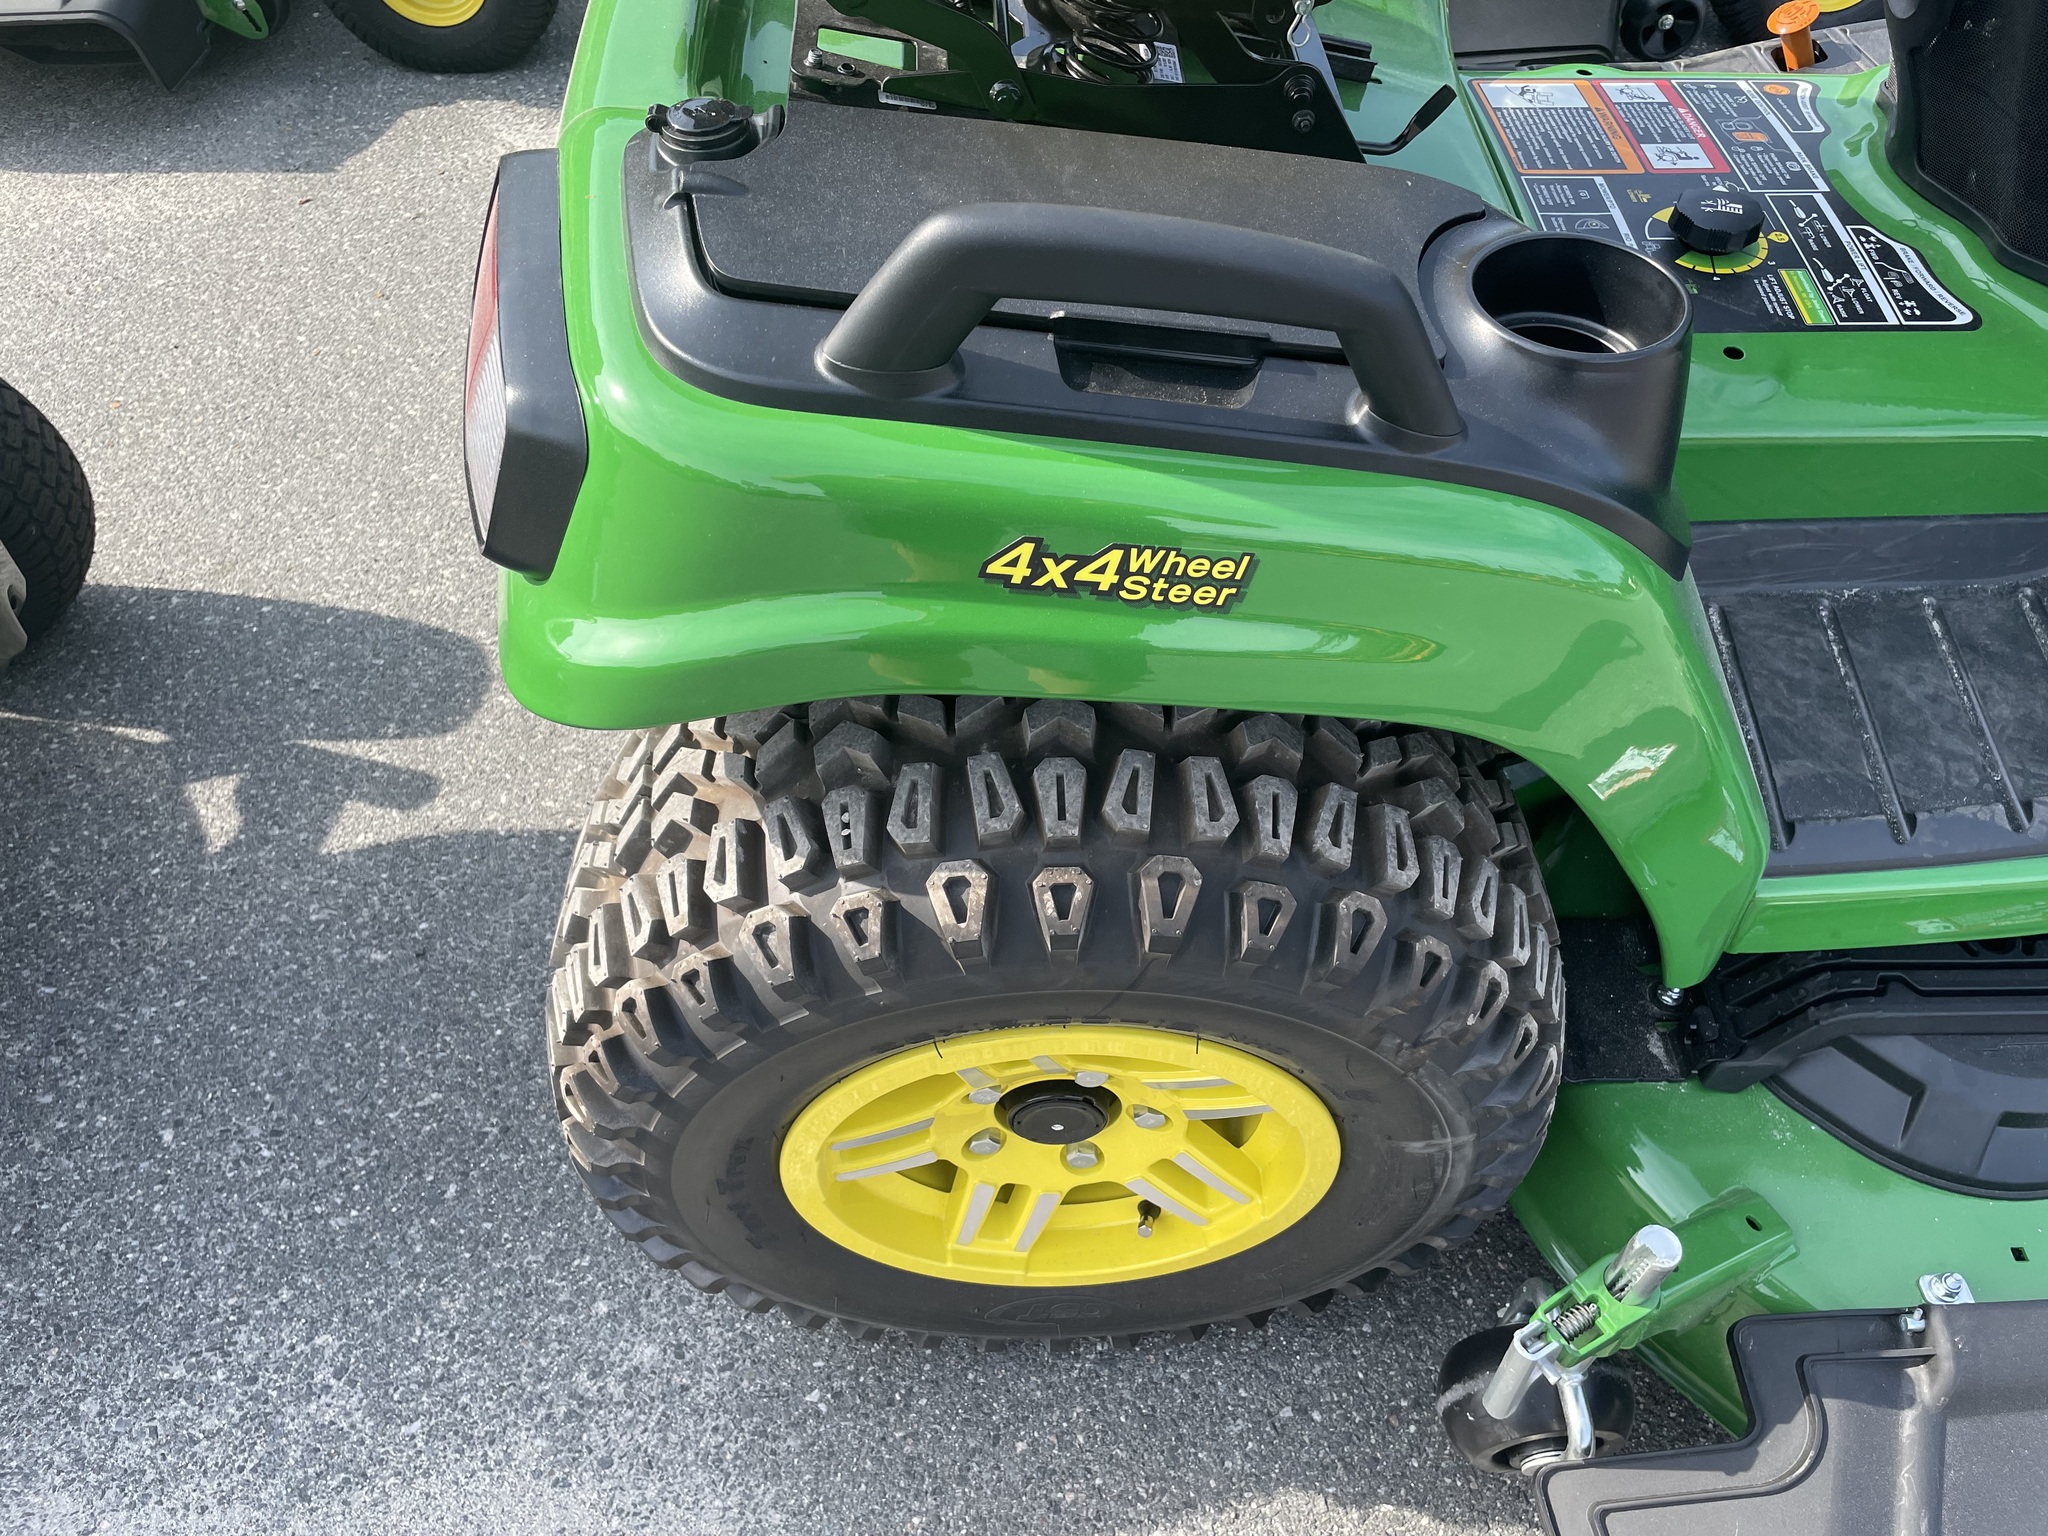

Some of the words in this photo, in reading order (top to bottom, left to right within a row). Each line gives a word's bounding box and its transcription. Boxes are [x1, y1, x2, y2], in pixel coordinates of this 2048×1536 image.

[1597, 112, 1622, 140] WARNING
[1682, 112, 1706, 138] DANGER
[1794, 152, 1807, 161] PARK
[1803, 164, 1819, 178] BRAKE
[1774, 232, 1786, 242] 2.5
[1844, 240, 1862, 258] POWER
[1856, 258, 1867, 270] LIFT
[1868, 249, 1879, 260] FWD
[1892, 289, 1902, 299] REV
[1900, 247, 1915, 264] BRAKE
[1913, 264, 1936, 290] FORWARD
[1937, 293, 1966, 316] REVERSE
[1767, 274, 1777, 286] LIFT
[1773, 285, 1788, 304] ADJUST
[1783, 305, 1795, 320] STOP
[1852, 298, 1864, 314] LOWER
[1861, 288, 1873, 302] FLOAT
[986, 541, 1124, 592] 4x4
[1128, 548, 1251, 580] Wheel
[1118, 575, 1238, 606] Steer
